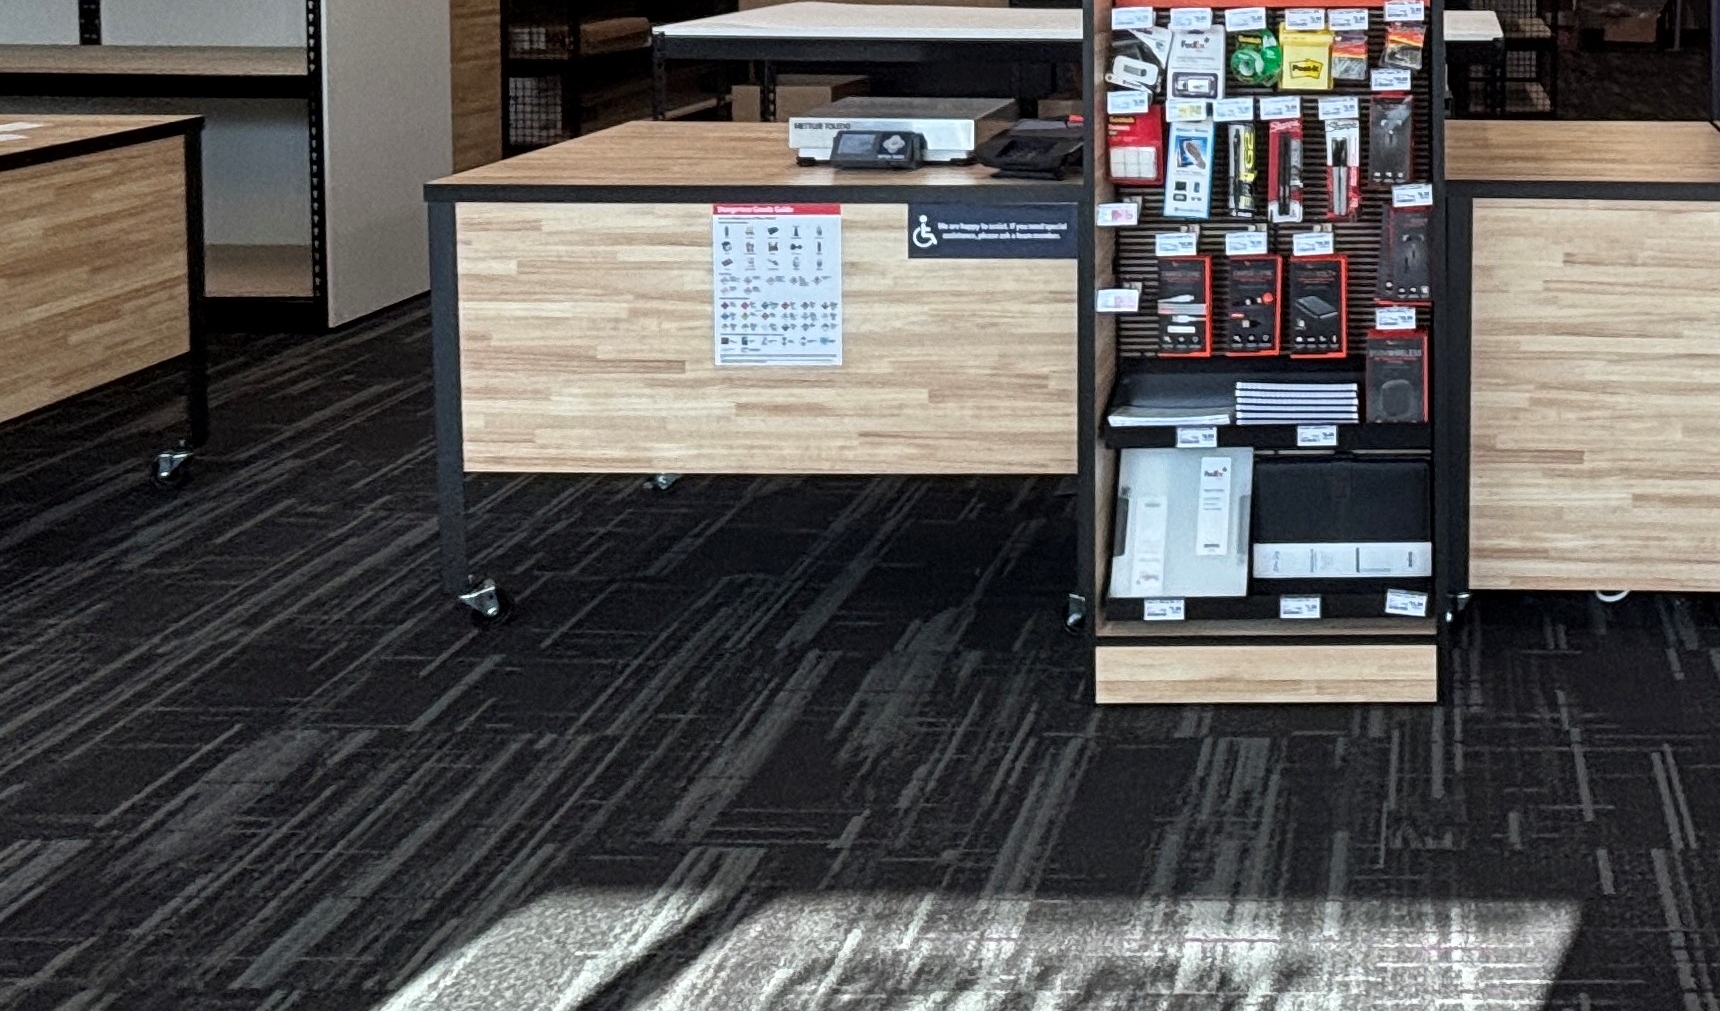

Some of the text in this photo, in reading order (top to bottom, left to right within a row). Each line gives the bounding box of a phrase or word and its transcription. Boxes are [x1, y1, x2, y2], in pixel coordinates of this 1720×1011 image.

[1292, 64, 1320, 72] Post-it
[937, 222, 948, 230] We
[960, 222, 979, 231] happy
[980, 222, 988, 230] to
[1028, 222, 1044, 230] need
[1044, 222, 1068, 231] special
[978, 231, 999, 240] please
[999, 231, 1010, 239] ask
